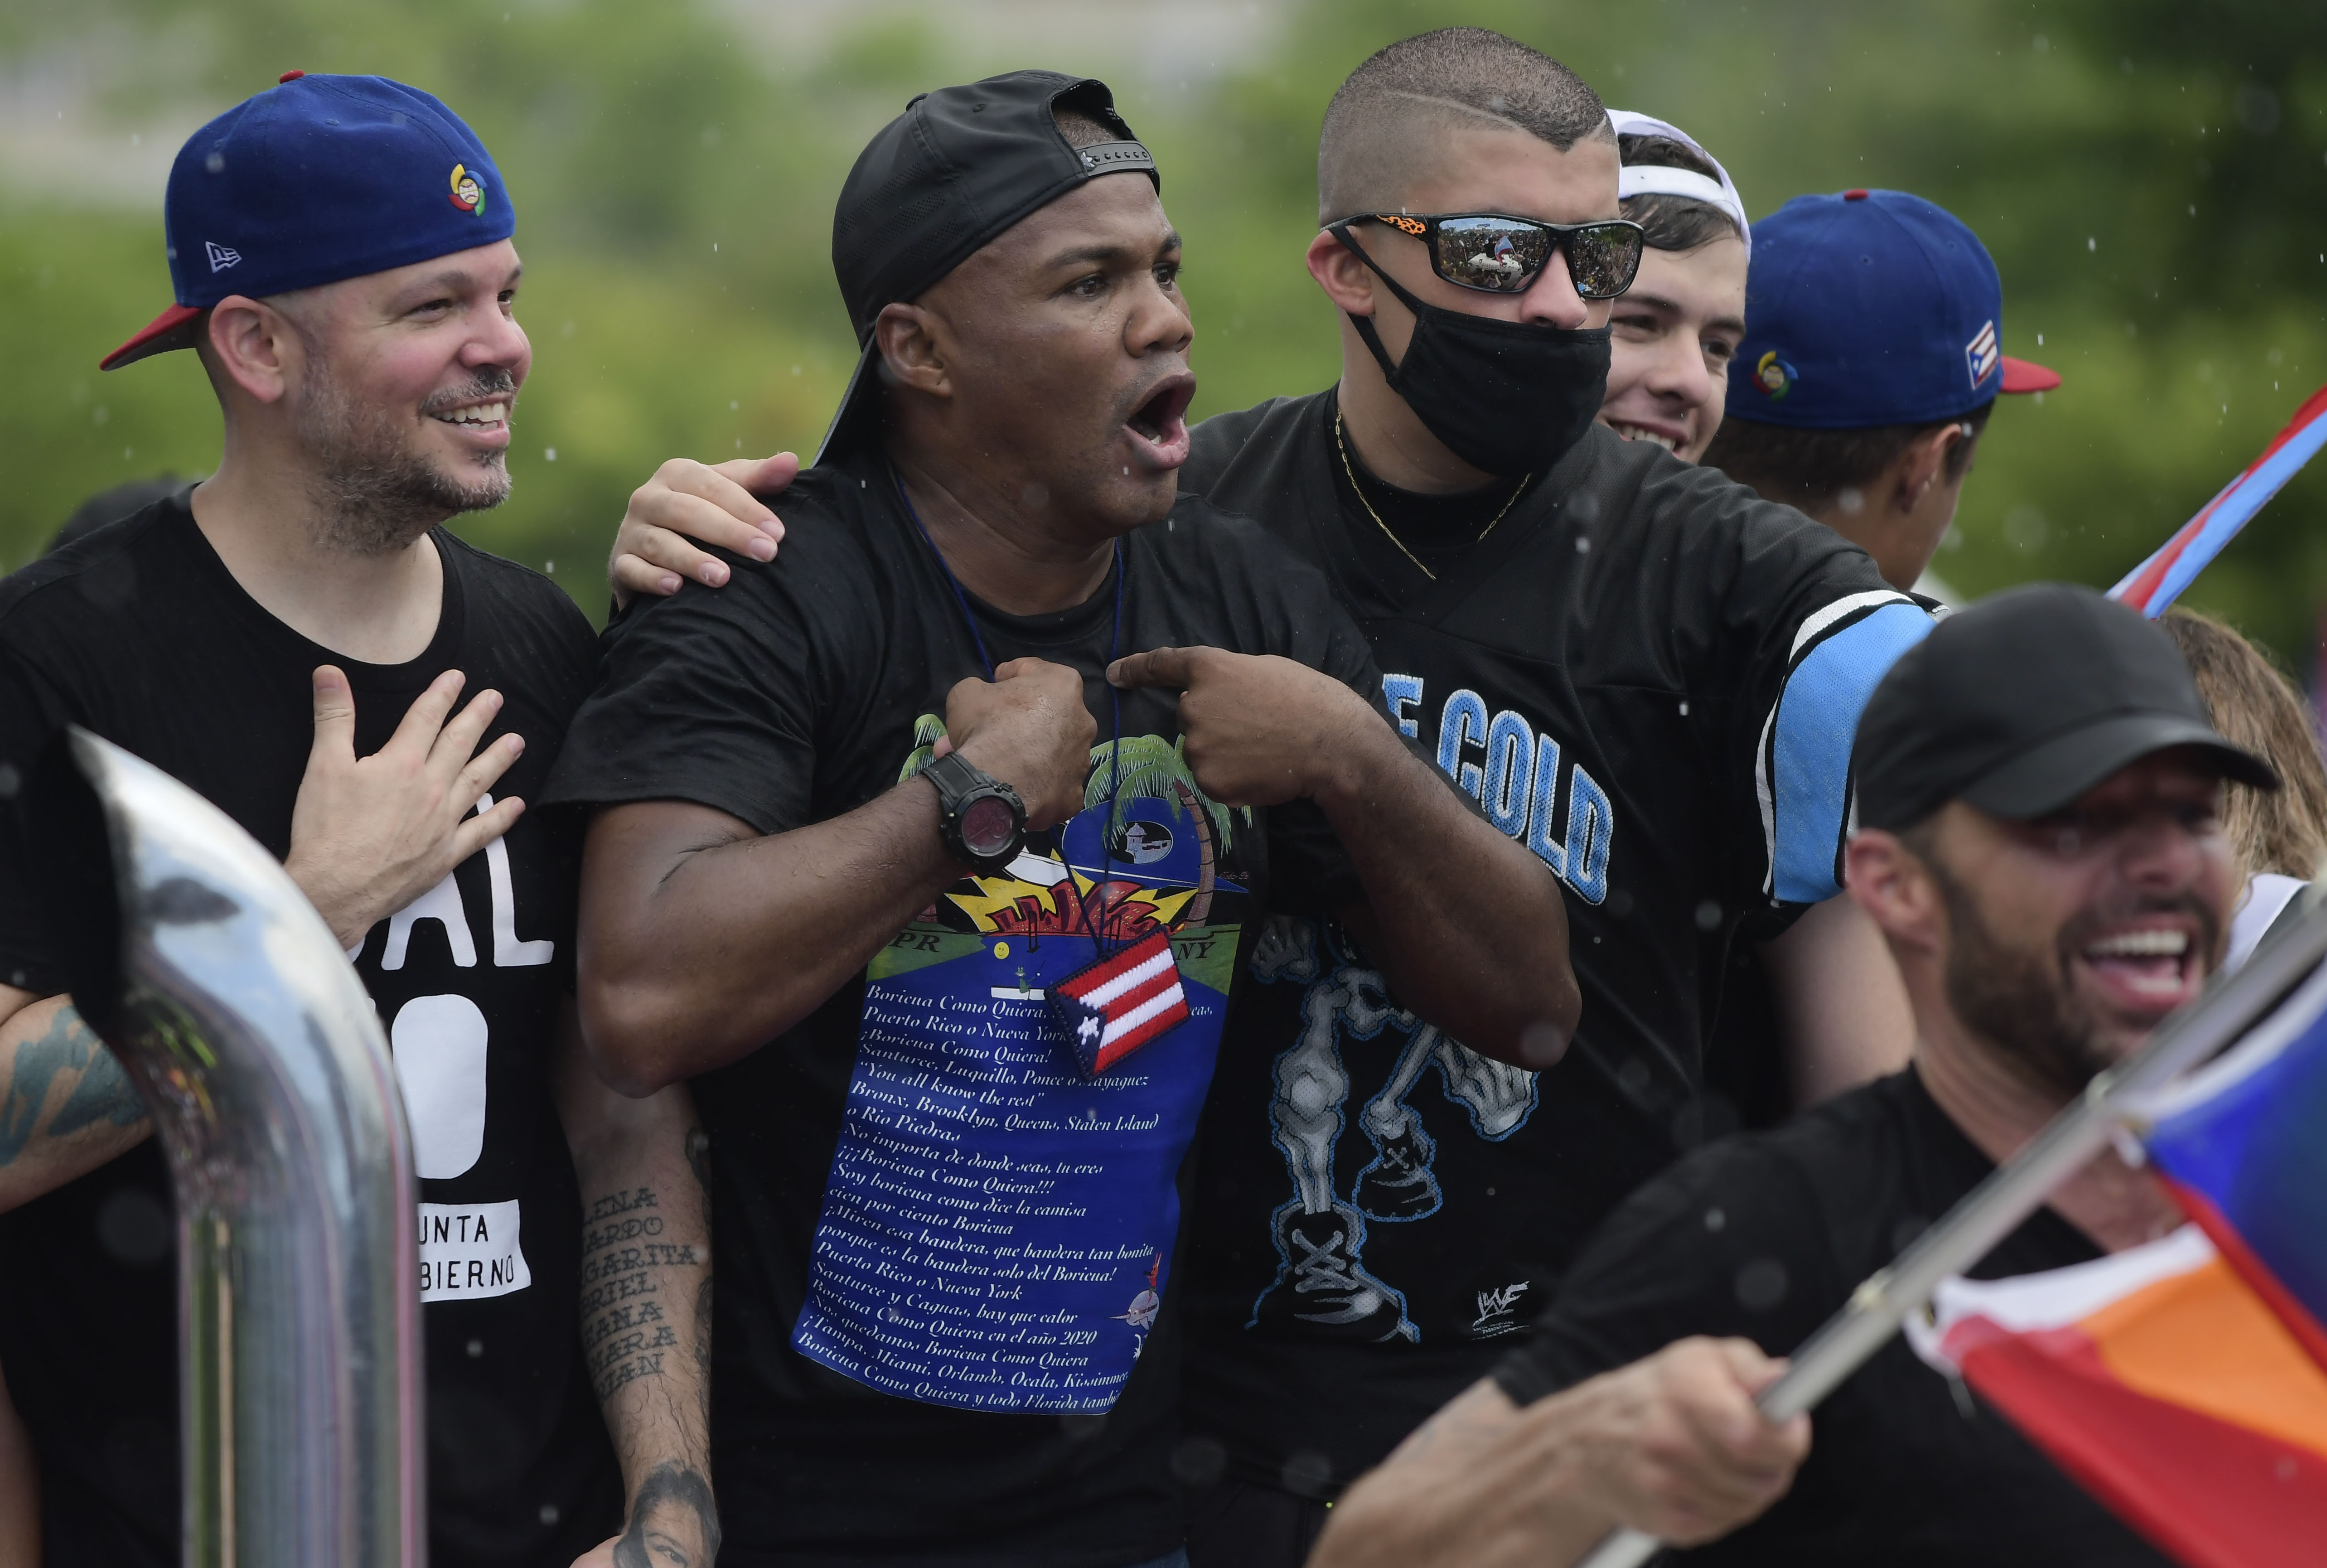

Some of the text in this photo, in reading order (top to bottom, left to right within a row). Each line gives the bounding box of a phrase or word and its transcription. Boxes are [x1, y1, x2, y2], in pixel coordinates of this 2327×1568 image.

[1437, 689, 1613, 905] COLD
[347, 793, 554, 970] AL
[888, 933, 940, 952] PR
[1176, 942, 1216, 960] NY
[864, 1007, 920, 1027] Puerto
[925, 1016, 962, 1033] Rico
[981, 1022, 1029, 1040] Nueva
[867, 985, 933, 1007] Boricua
[940, 996, 987, 1013] Como
[992, 1001, 1046, 1019] Quiera,
[860, 1044, 1149, 1091] Santurce, Luquillo, Ponce o ayaguez
[861, 1029, 1052, 1065] ¡Boricua Como Quiera!
[851, 1081, 1159, 1131] Bronx, Brooklyn, Queens, Staten Island
[901, 1073, 929, 1088] all
[930, 1077, 975, 1099] know
[979, 1089, 1004, 1105] the
[861, 1106, 890, 1124] Rio
[895, 1115, 960, 1141] Piedras
[838, 1146, 1055, 1194] ¡¡¡Boricua Como Quiera!!!
[845, 1123, 1103, 1174] No importa de donde seas, tu eres
[830, 1186, 1013, 1234] cien por ciento Boricua
[834, 1163, 1086, 1216] Soy boricua como dice la camisa
[418, 1215, 489, 1245] UNTA
[584, 1216, 663, 1256] ARDO
[818, 1225, 1117, 1281] porque es la bandera solo del Boricua!
[825, 1205, 1153, 1259] ¡Miren esa bandera, que bandera tan bonita
[420, 1254, 514, 1291] BIERNO
[583, 1244, 698, 1284] GARITA
[817, 1242, 871, 1269] Puerto
[875, 1262, 912, 1282] Rico
[931, 1277, 981, 1296] Nueva
[988, 1284, 1022, 1300] York
[813, 1279, 1097, 1345] Boricua Como Quiera en el año 2020
[814, 1262, 885, 1297] Santurce
[887, 1293, 901, 1304] y
[907, 1294, 970, 1317] Caguas,
[1010, 1313, 1036, 1326] que
[1040, 1308, 1078, 1323] calor
[803, 1315, 866, 1355] ¡Tampa,
[871, 1349, 930, 1375] Miami,
[938, 1365, 1004, 1384] Orlando,
[1011, 1371, 1058, 1389] Ocala,
[813, 1295, 1088, 1369] Nos quedamos Boricua Como Quiera
[798, 1332, 859, 1371] Boricua
[865, 1365, 909, 1390] Como
[914, 1382, 969, 1402] Quiera
[972, 1395, 984, 1407] y
[988, 1391, 1020, 1407] todo
[1024, 1394, 1078, 1408] Florida
